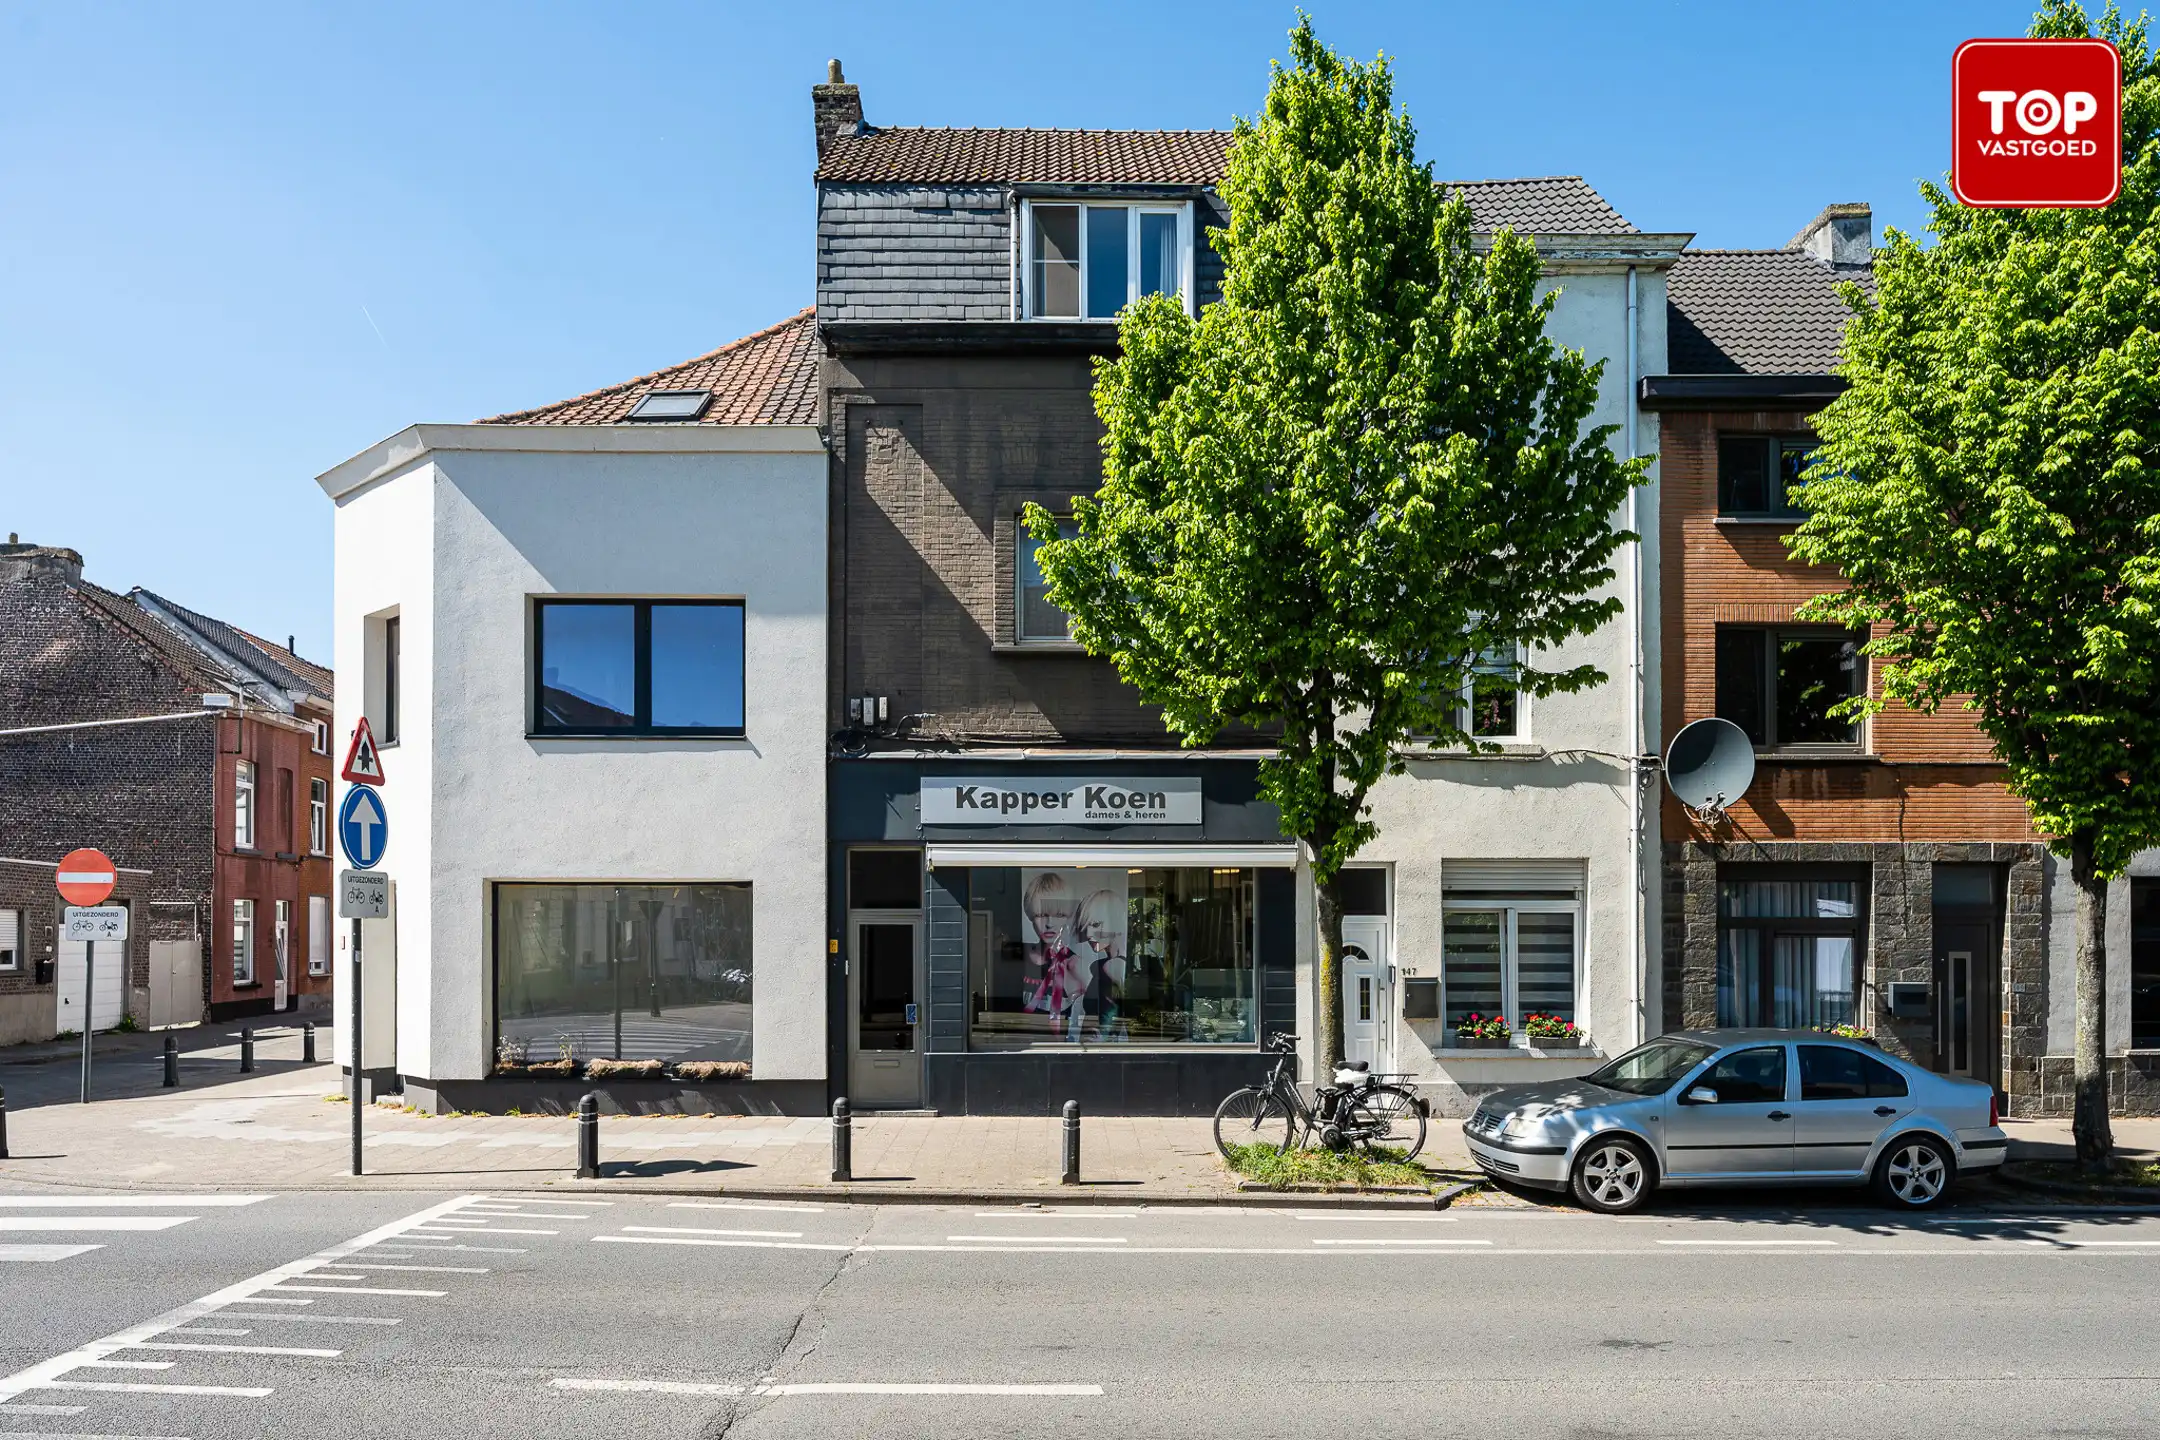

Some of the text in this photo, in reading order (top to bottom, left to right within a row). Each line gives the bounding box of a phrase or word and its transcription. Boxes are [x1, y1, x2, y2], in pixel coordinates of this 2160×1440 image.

[956, 786, 1167, 815] Kapper Koen
[1085, 810, 1166, 819] dames & heren
[347, 875, 384, 885] UITGEZONDERD
